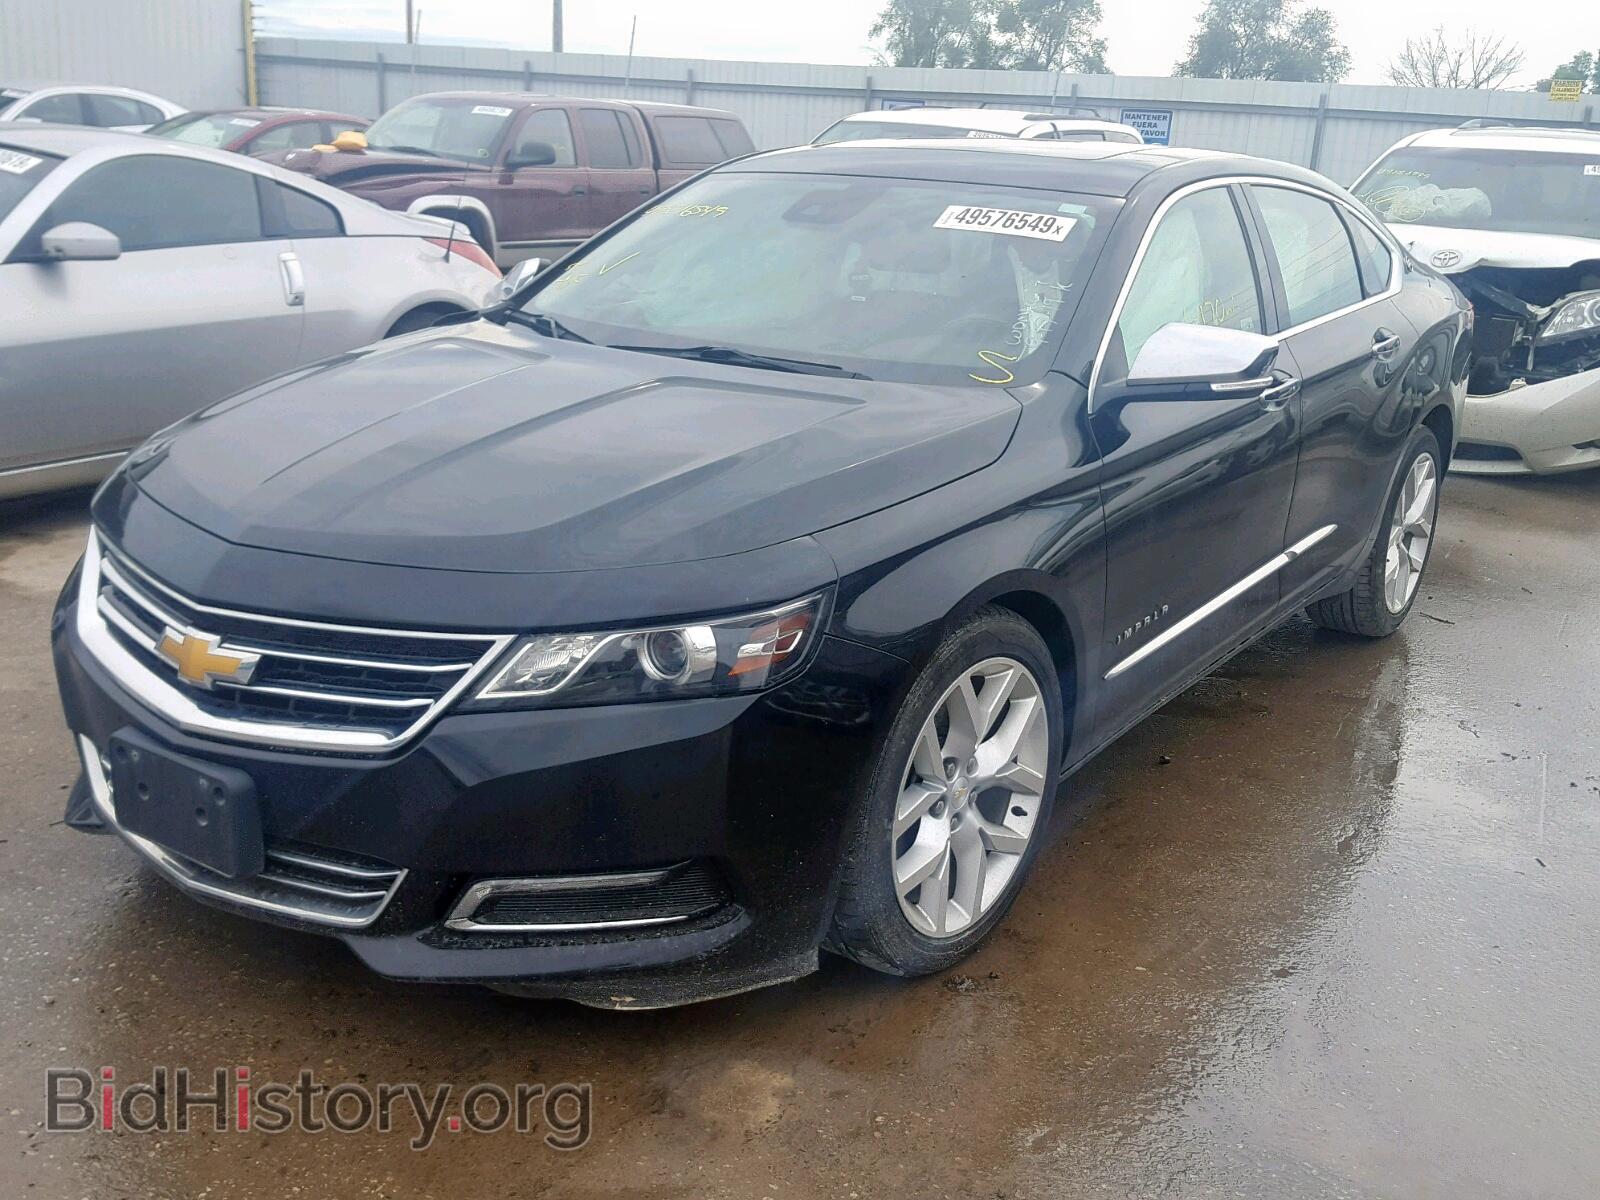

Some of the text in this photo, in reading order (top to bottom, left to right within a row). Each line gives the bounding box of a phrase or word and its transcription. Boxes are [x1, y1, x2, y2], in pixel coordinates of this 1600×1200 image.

[1124, 113, 1168, 121] MANTENER
[1132, 121, 1158, 129] FUERA
[1140, 129, 1166, 137] FAVOR
[1117, 604, 1169, 645] IMPALA
